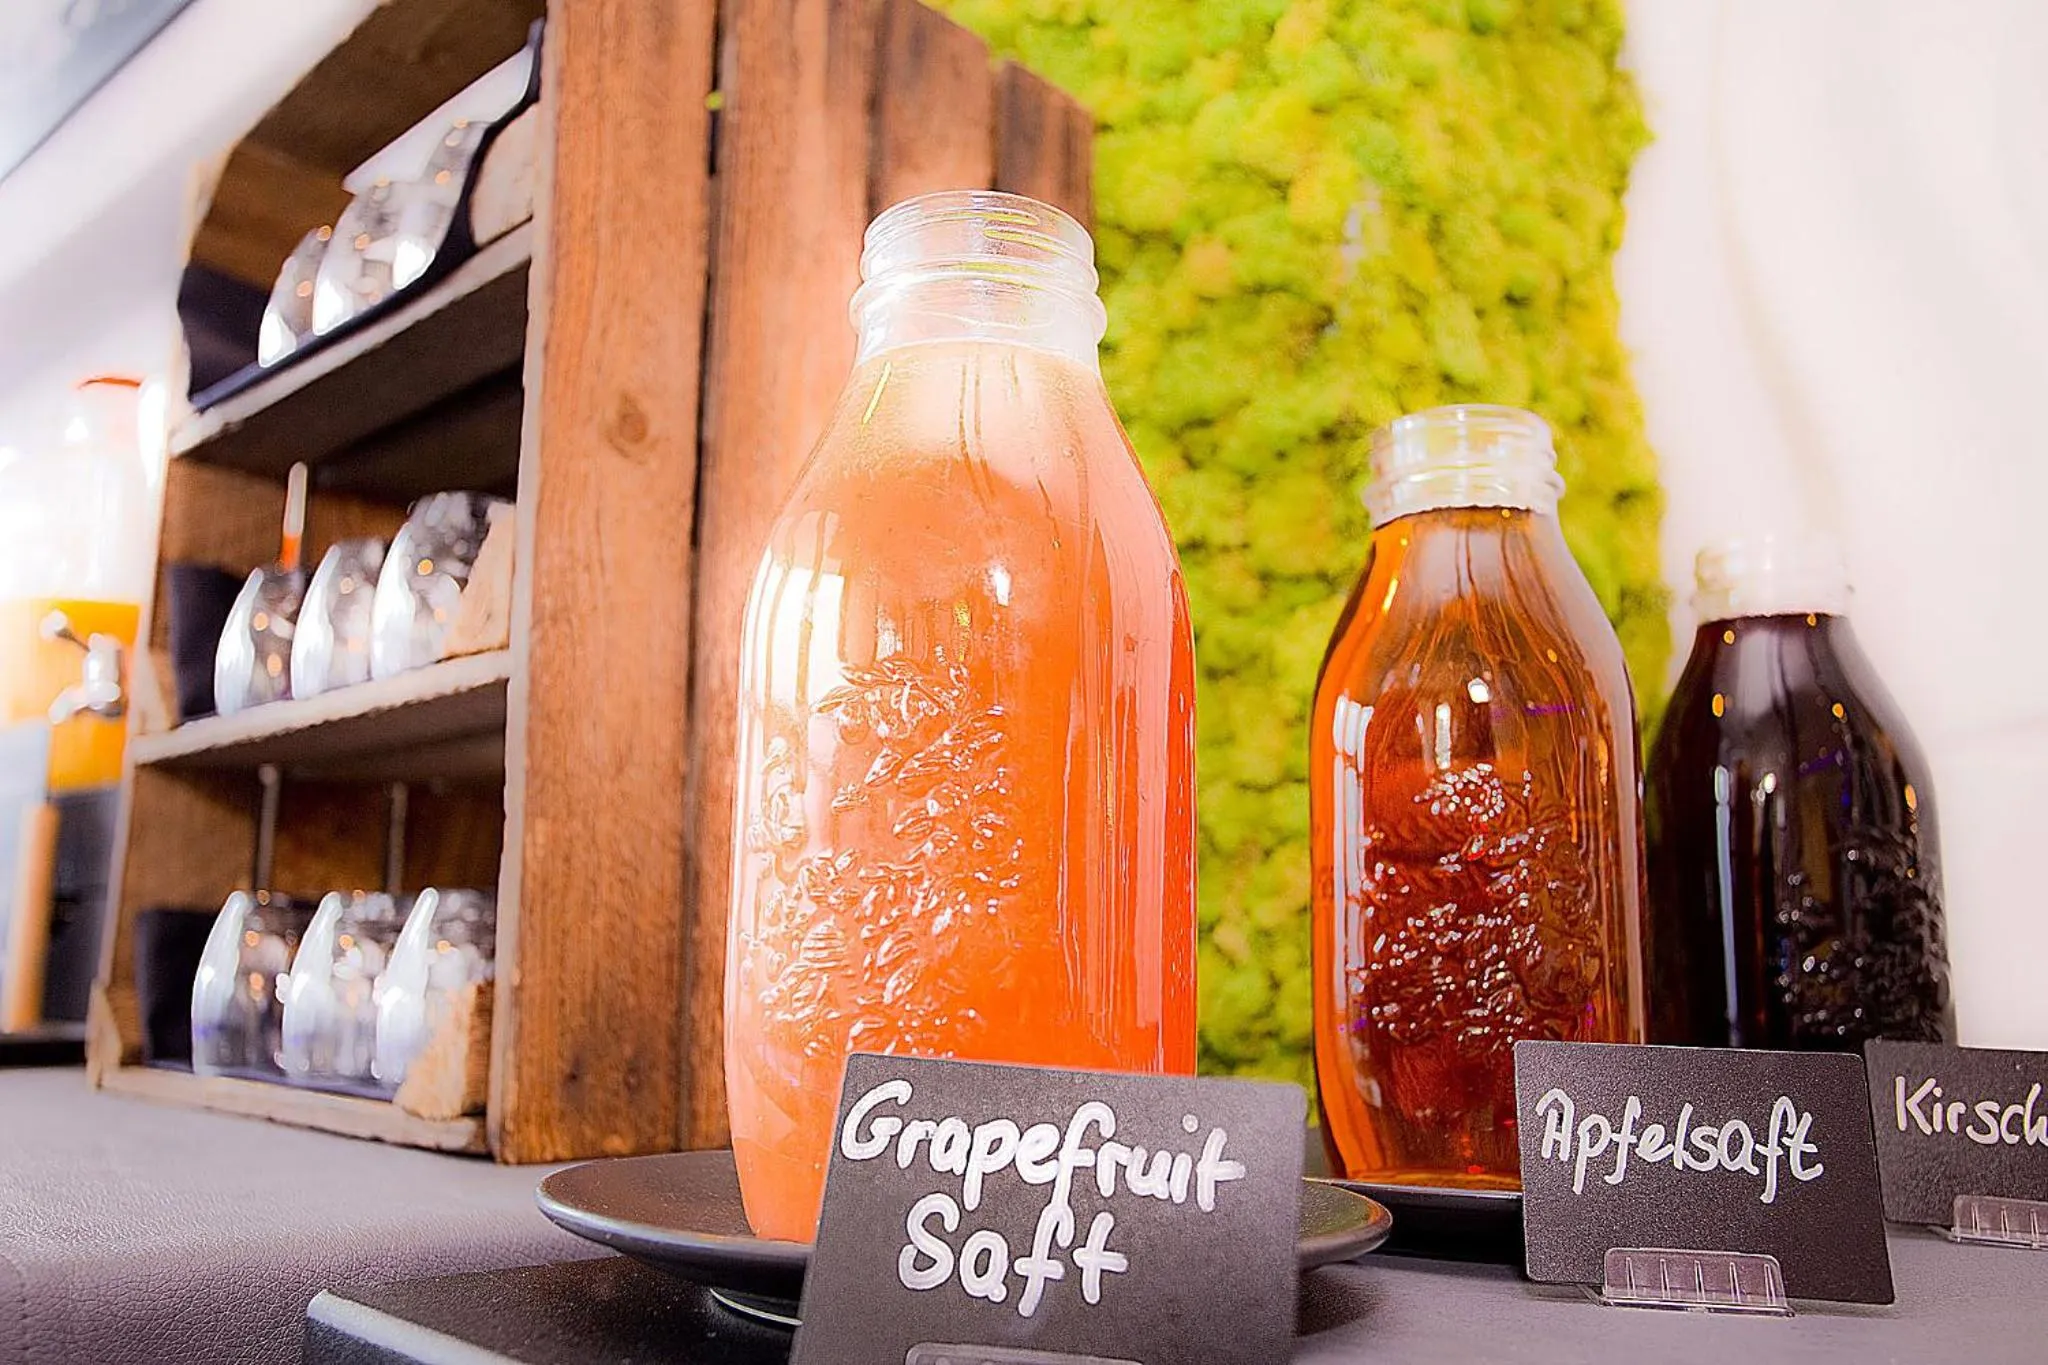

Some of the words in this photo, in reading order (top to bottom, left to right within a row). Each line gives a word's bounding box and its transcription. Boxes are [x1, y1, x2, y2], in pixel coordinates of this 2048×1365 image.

[840, 1079, 1246, 1212] Grapefruit
[1535, 1088, 1824, 1203] Apfelsaft
[898, 1192, 1129, 1317] Saft
